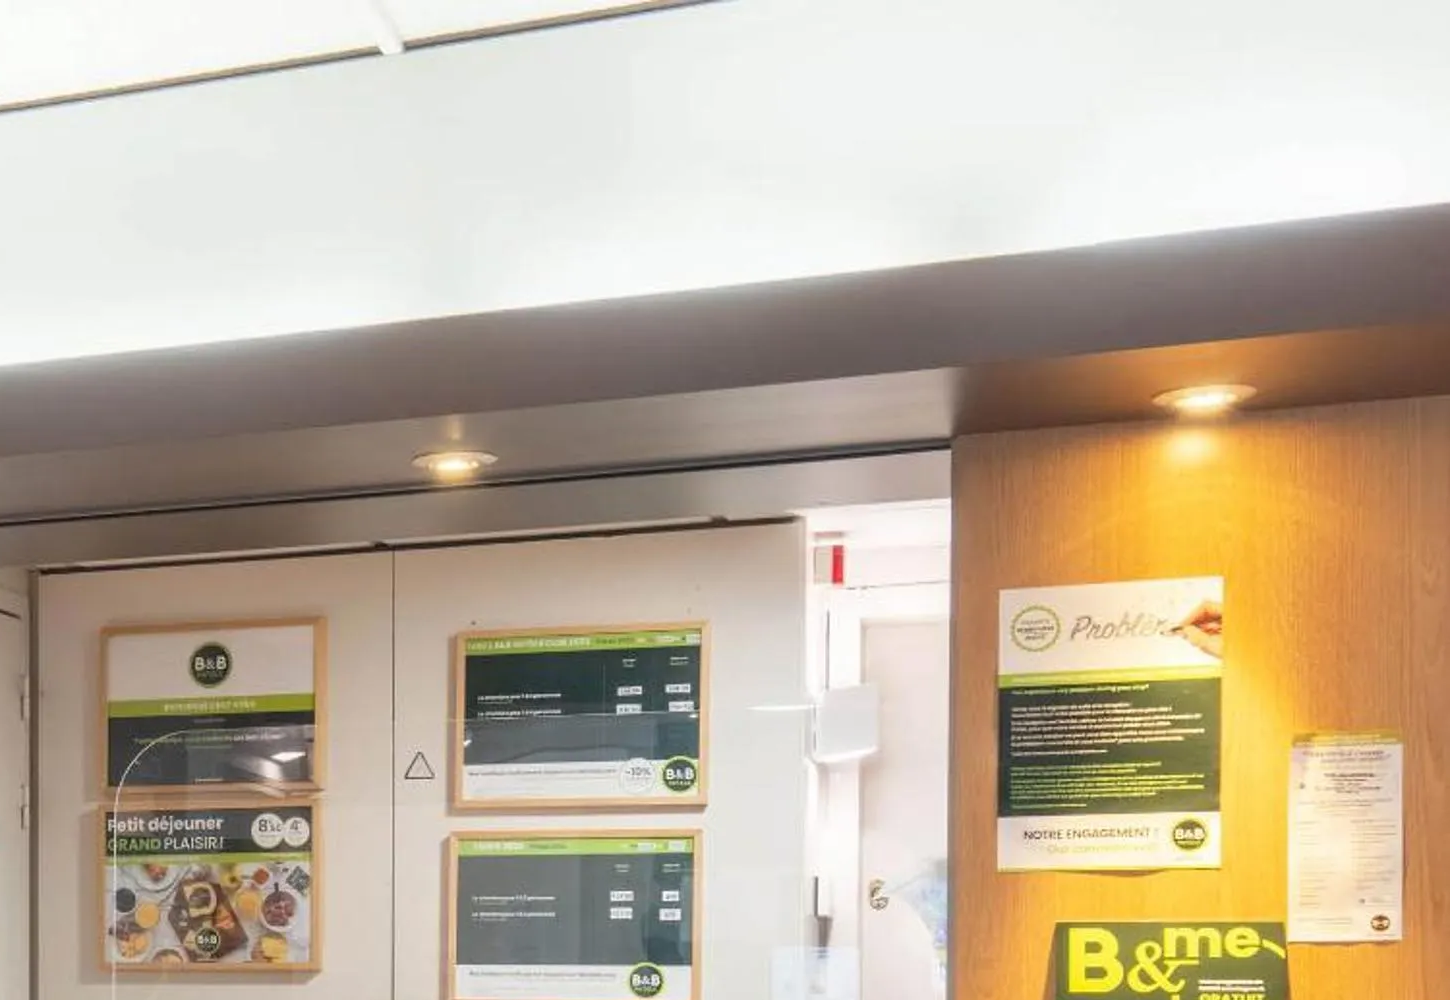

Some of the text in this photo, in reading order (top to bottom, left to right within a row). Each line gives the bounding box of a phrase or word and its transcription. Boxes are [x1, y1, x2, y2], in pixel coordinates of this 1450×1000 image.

[195, 656, 228, 672] B&B
[665, 766, 695, 781] B&B
[107, 814, 225, 836] Petit déjeuner
[1023, 828, 1064, 841] NOTRE
[1066, 827, 1151, 840] ENGAGEMENT
[1174, 828, 1205, 840] B&B
[107, 836, 162, 852] GRAND
[631, 973, 661, 987] B&B
